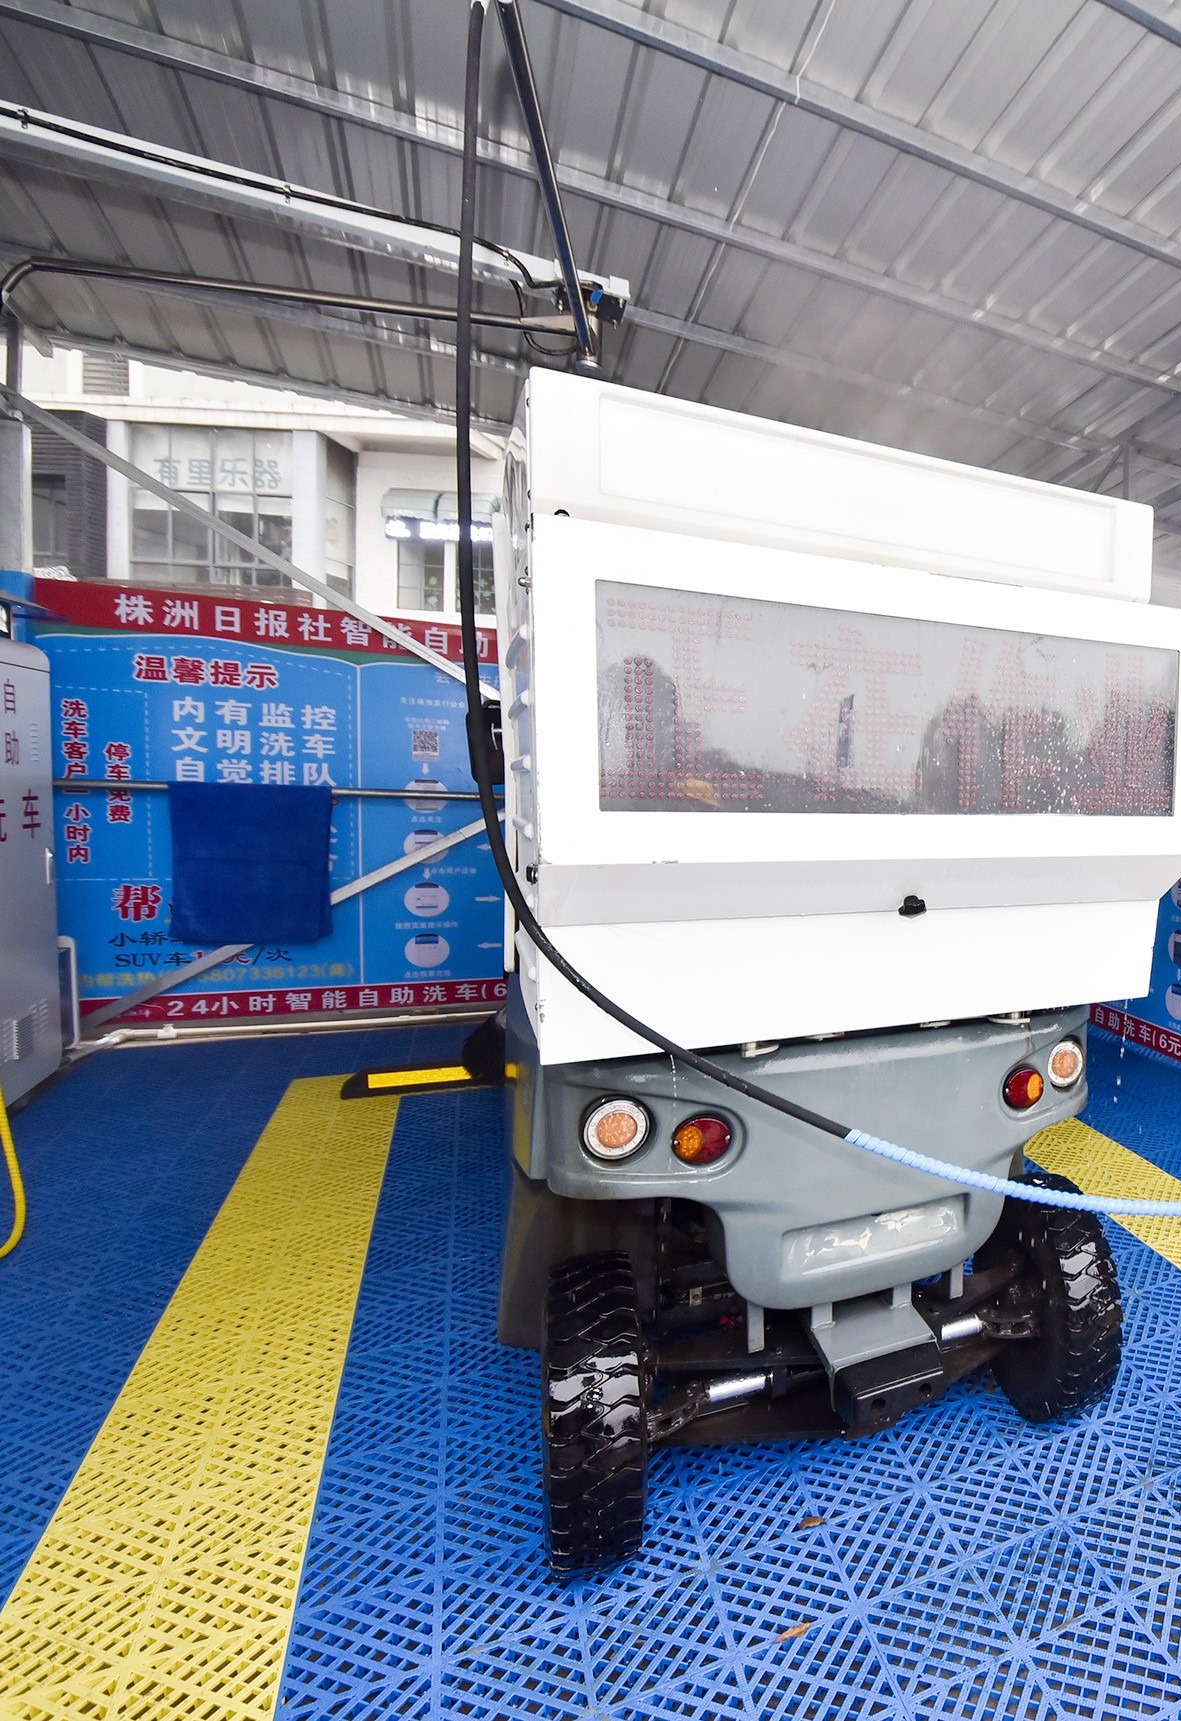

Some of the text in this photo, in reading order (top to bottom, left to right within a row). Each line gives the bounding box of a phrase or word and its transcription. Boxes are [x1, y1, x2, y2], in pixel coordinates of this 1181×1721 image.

[133, 653, 279, 691] 温馨提示
[172, 696, 337, 731] 内有监控
[171, 726, 337, 759] 文明洗车
[175, 757, 337, 786] 自觉排队
